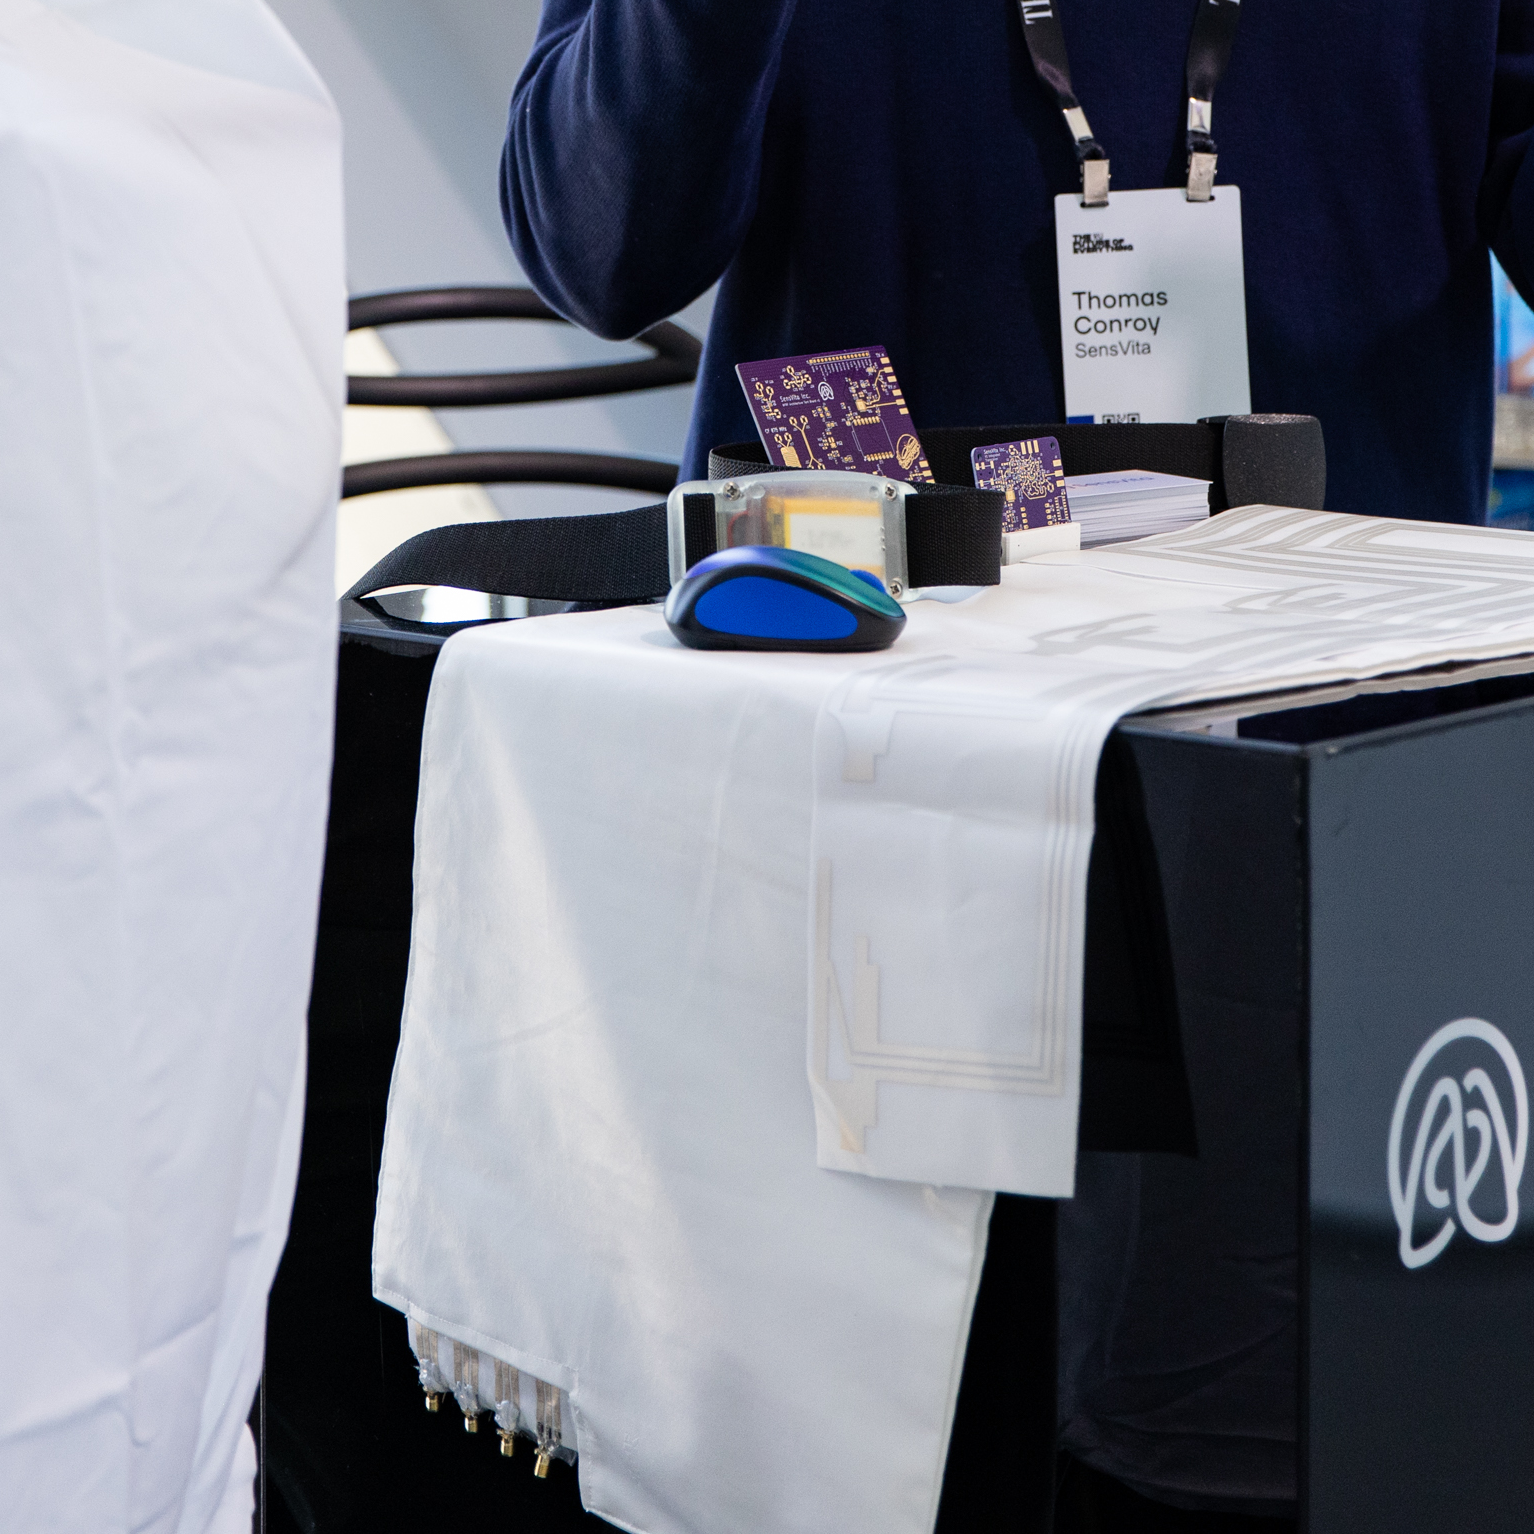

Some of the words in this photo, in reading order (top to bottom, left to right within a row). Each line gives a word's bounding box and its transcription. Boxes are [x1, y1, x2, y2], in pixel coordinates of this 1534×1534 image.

[1072, 291, 1168, 310] Thomas
[1074, 316, 1160, 336] Conroy
[1075, 340, 1152, 359] SensVita
